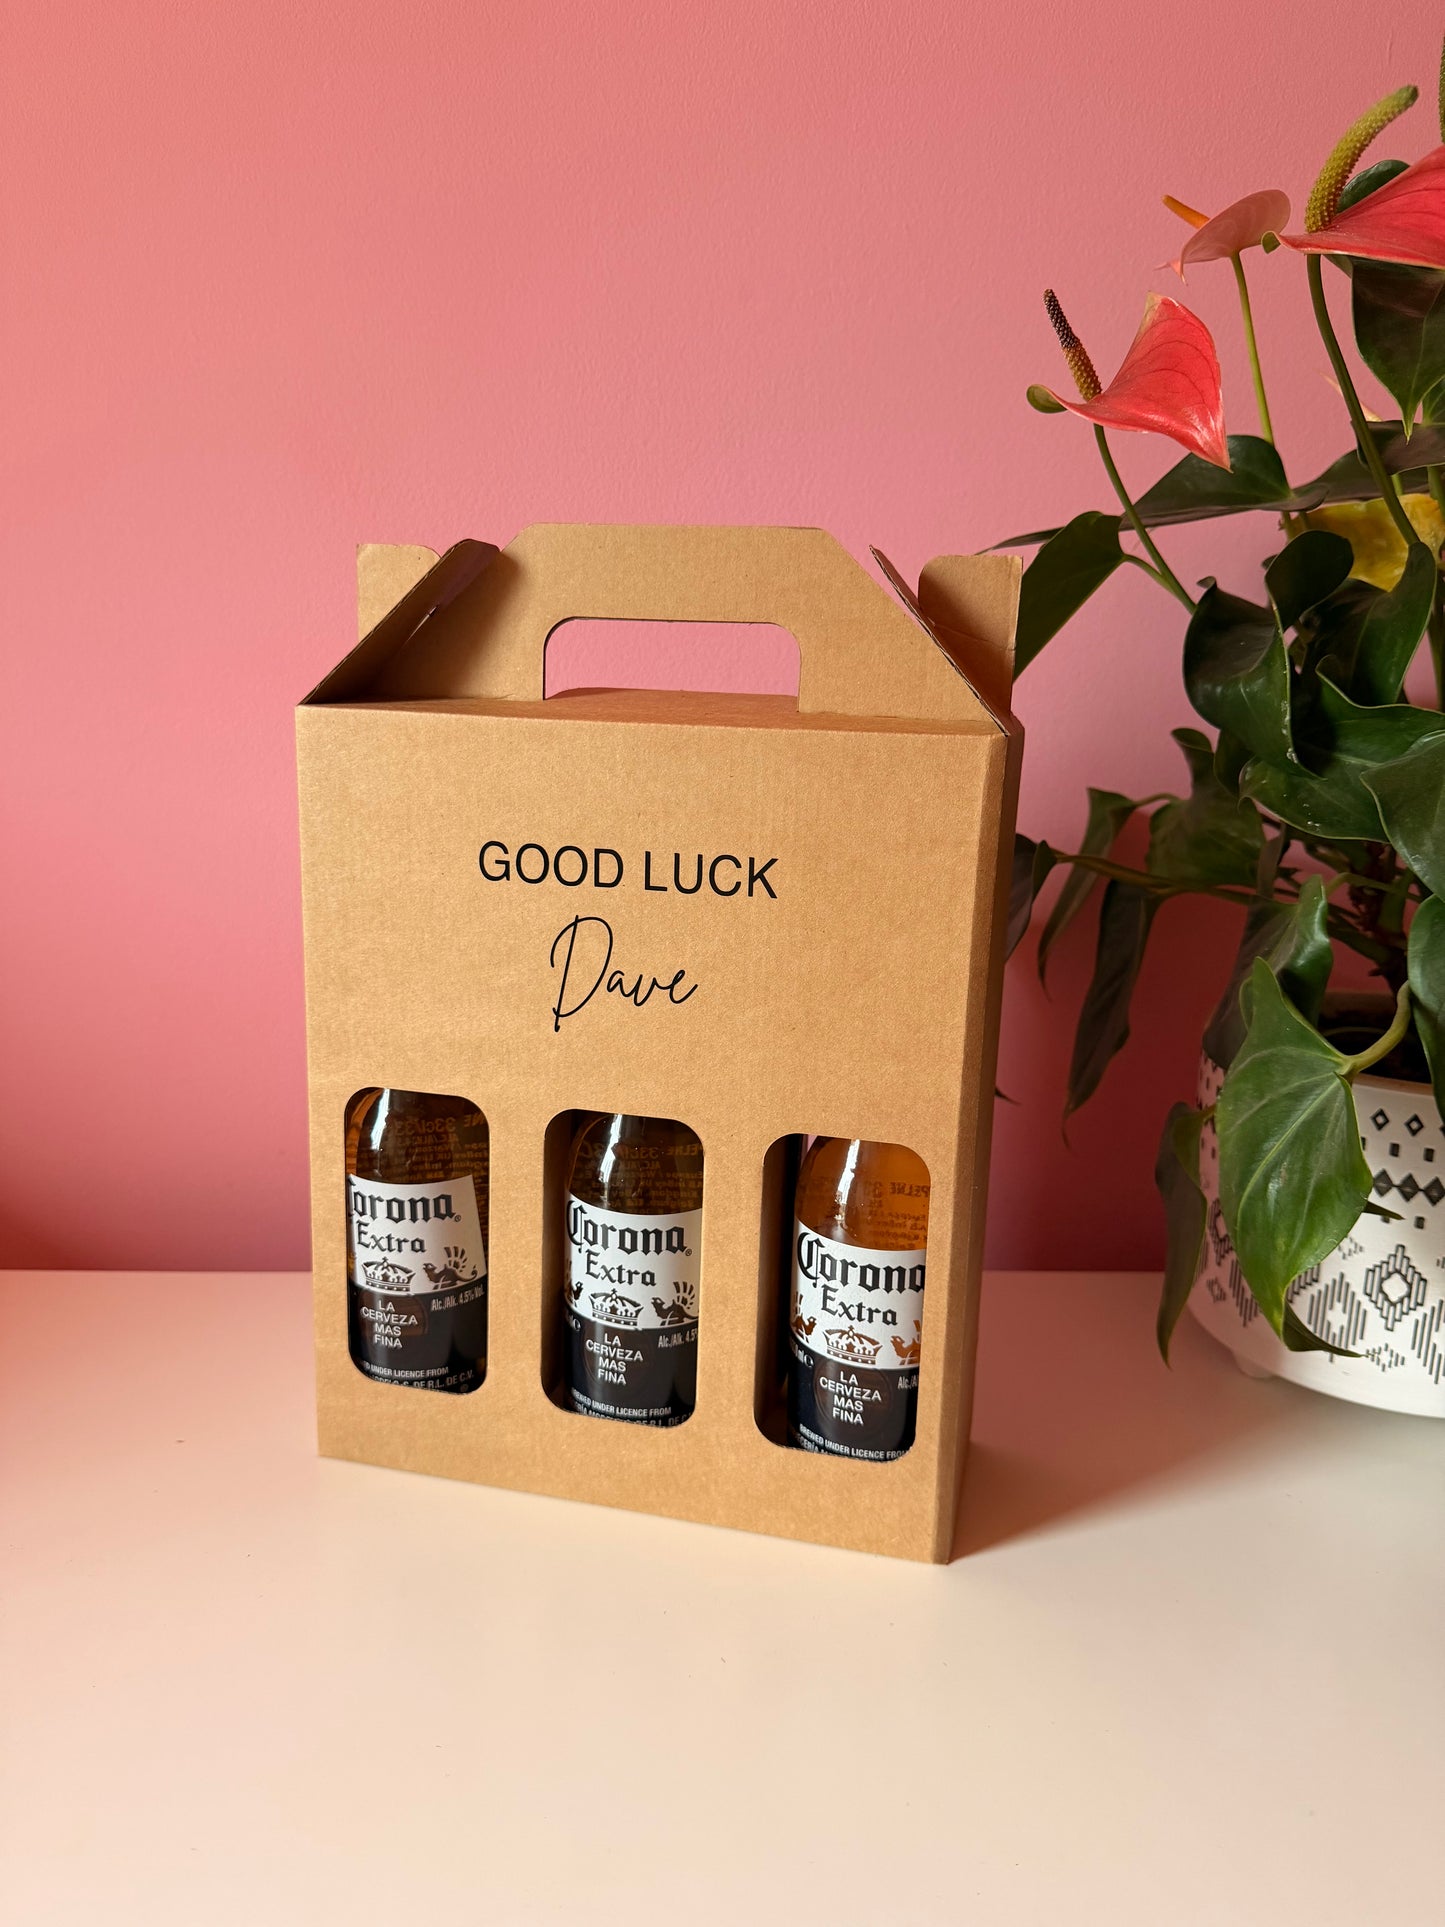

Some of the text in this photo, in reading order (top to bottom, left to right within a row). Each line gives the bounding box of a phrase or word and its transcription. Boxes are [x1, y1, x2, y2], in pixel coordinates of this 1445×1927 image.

[478, 840, 779, 899] GOOD LUCK
[550, 914, 699, 1032] Dave
[355, 1219, 427, 1253] Extra
[566, 1200, 688, 1255] Corona
[585, 1248, 657, 1287] Extra
[378, 1299, 396, 1312] LA
[821, 1283, 899, 1326] Extra
[361, 1306, 419, 1325] CERVEZA
[374, 1322, 402, 1337] MAS
[374, 1334, 403, 1349] FINA
[603, 1332, 622, 1347] LA
[585, 1338, 644, 1361] CERVEZA
[598, 1356, 627, 1373] MAS
[597, 1367, 627, 1386] FINA
[840, 1370, 859, 1386] LA
[818, 1375, 882, 1401] CERVEZA
[833, 1394, 864, 1412] MAS
[832, 1406, 865, 1426] FINA
